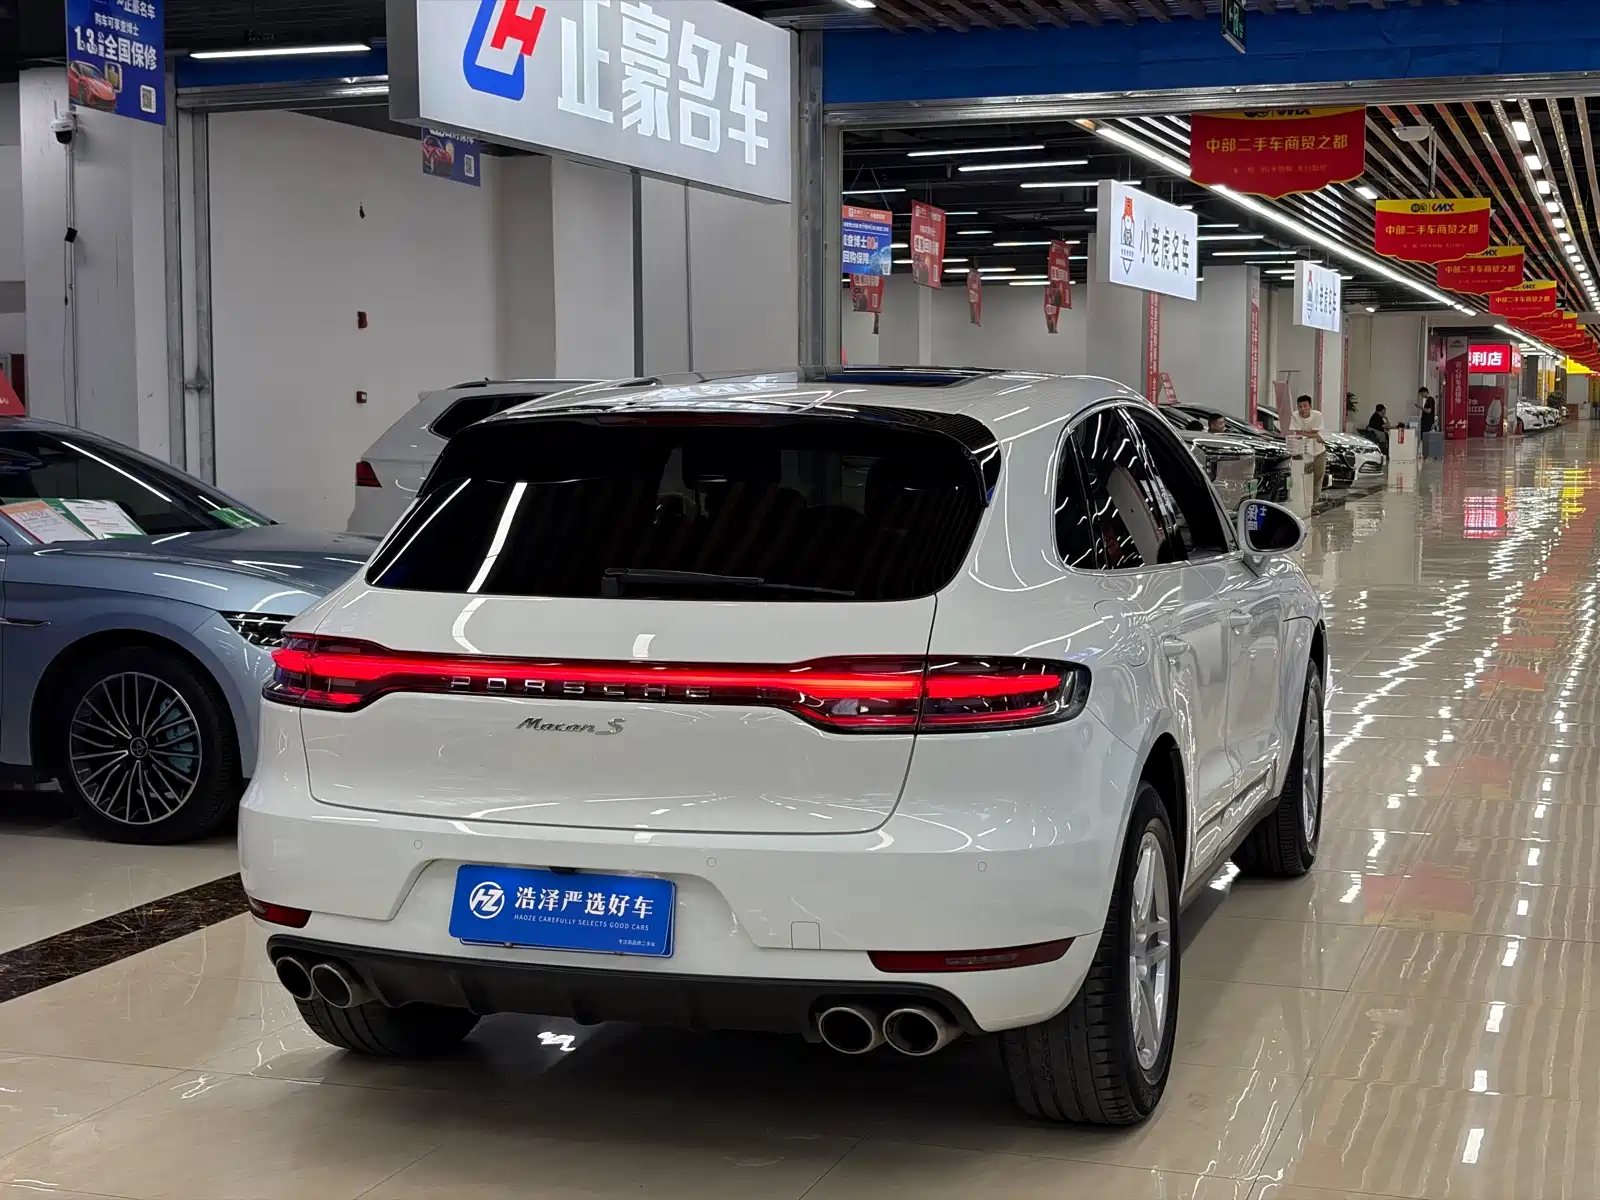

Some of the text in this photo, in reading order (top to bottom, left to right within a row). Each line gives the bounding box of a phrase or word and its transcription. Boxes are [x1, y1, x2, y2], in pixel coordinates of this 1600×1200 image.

[557, 0, 769, 166] 正豪名车
[1206, 134, 1349, 154] 中部二手车商贸之都
[1385, 224, 1479, 235] 中部二手车商贸之都
[1140, 219, 1190, 276] 小老虎名车
[451, 676, 711, 698] PORSCHE
[516, 716, 626, 735] Macan S
[514, 886, 654, 919] 浩泽严选好车
[514, 914, 536, 922] HAOZE
[538, 916, 576, 925] CAREFULLY
[578, 919, 607, 928] SELECTS
